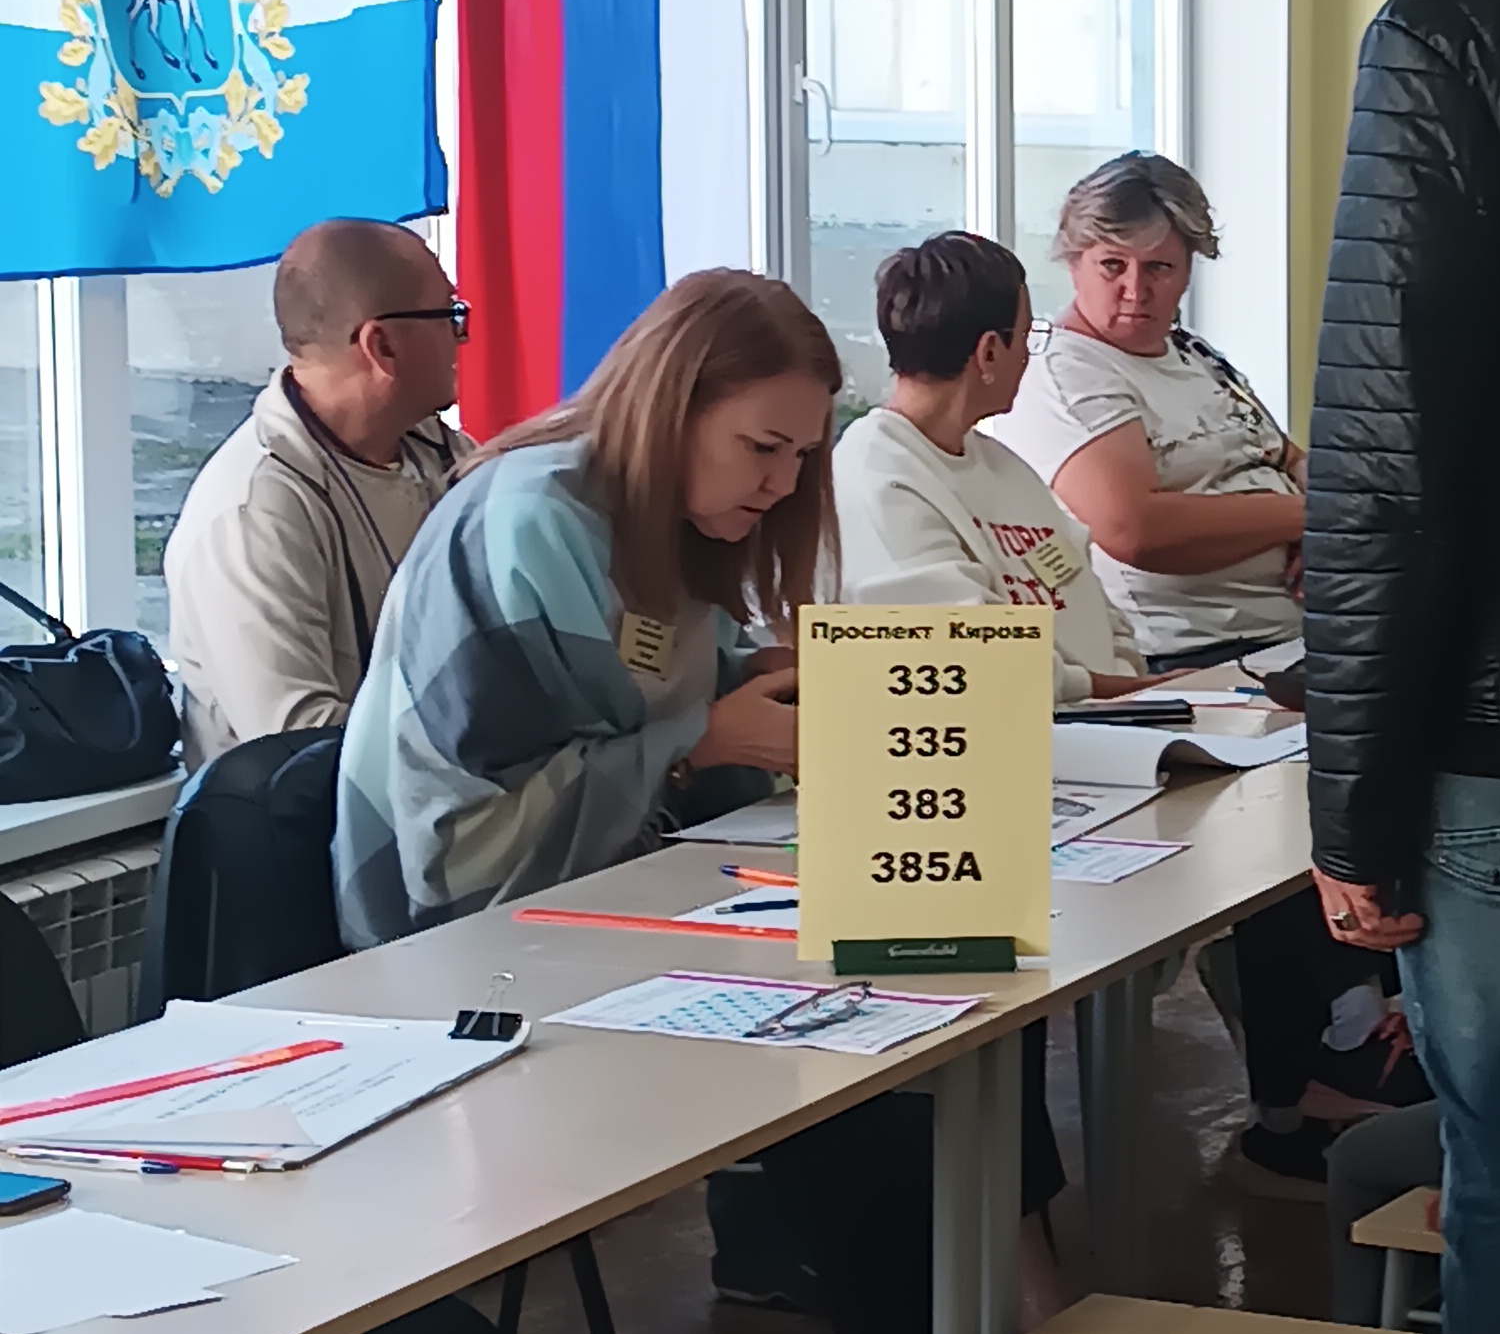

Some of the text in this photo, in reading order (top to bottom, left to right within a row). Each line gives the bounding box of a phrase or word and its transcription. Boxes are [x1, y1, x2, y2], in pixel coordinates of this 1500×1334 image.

[811, 622, 1041, 643] Проспект Кирова
[887, 664, 967, 696] 333
[887, 726, 967, 757] 335
[887, 788, 967, 820] 383
[871, 851, 982, 883] 385А
